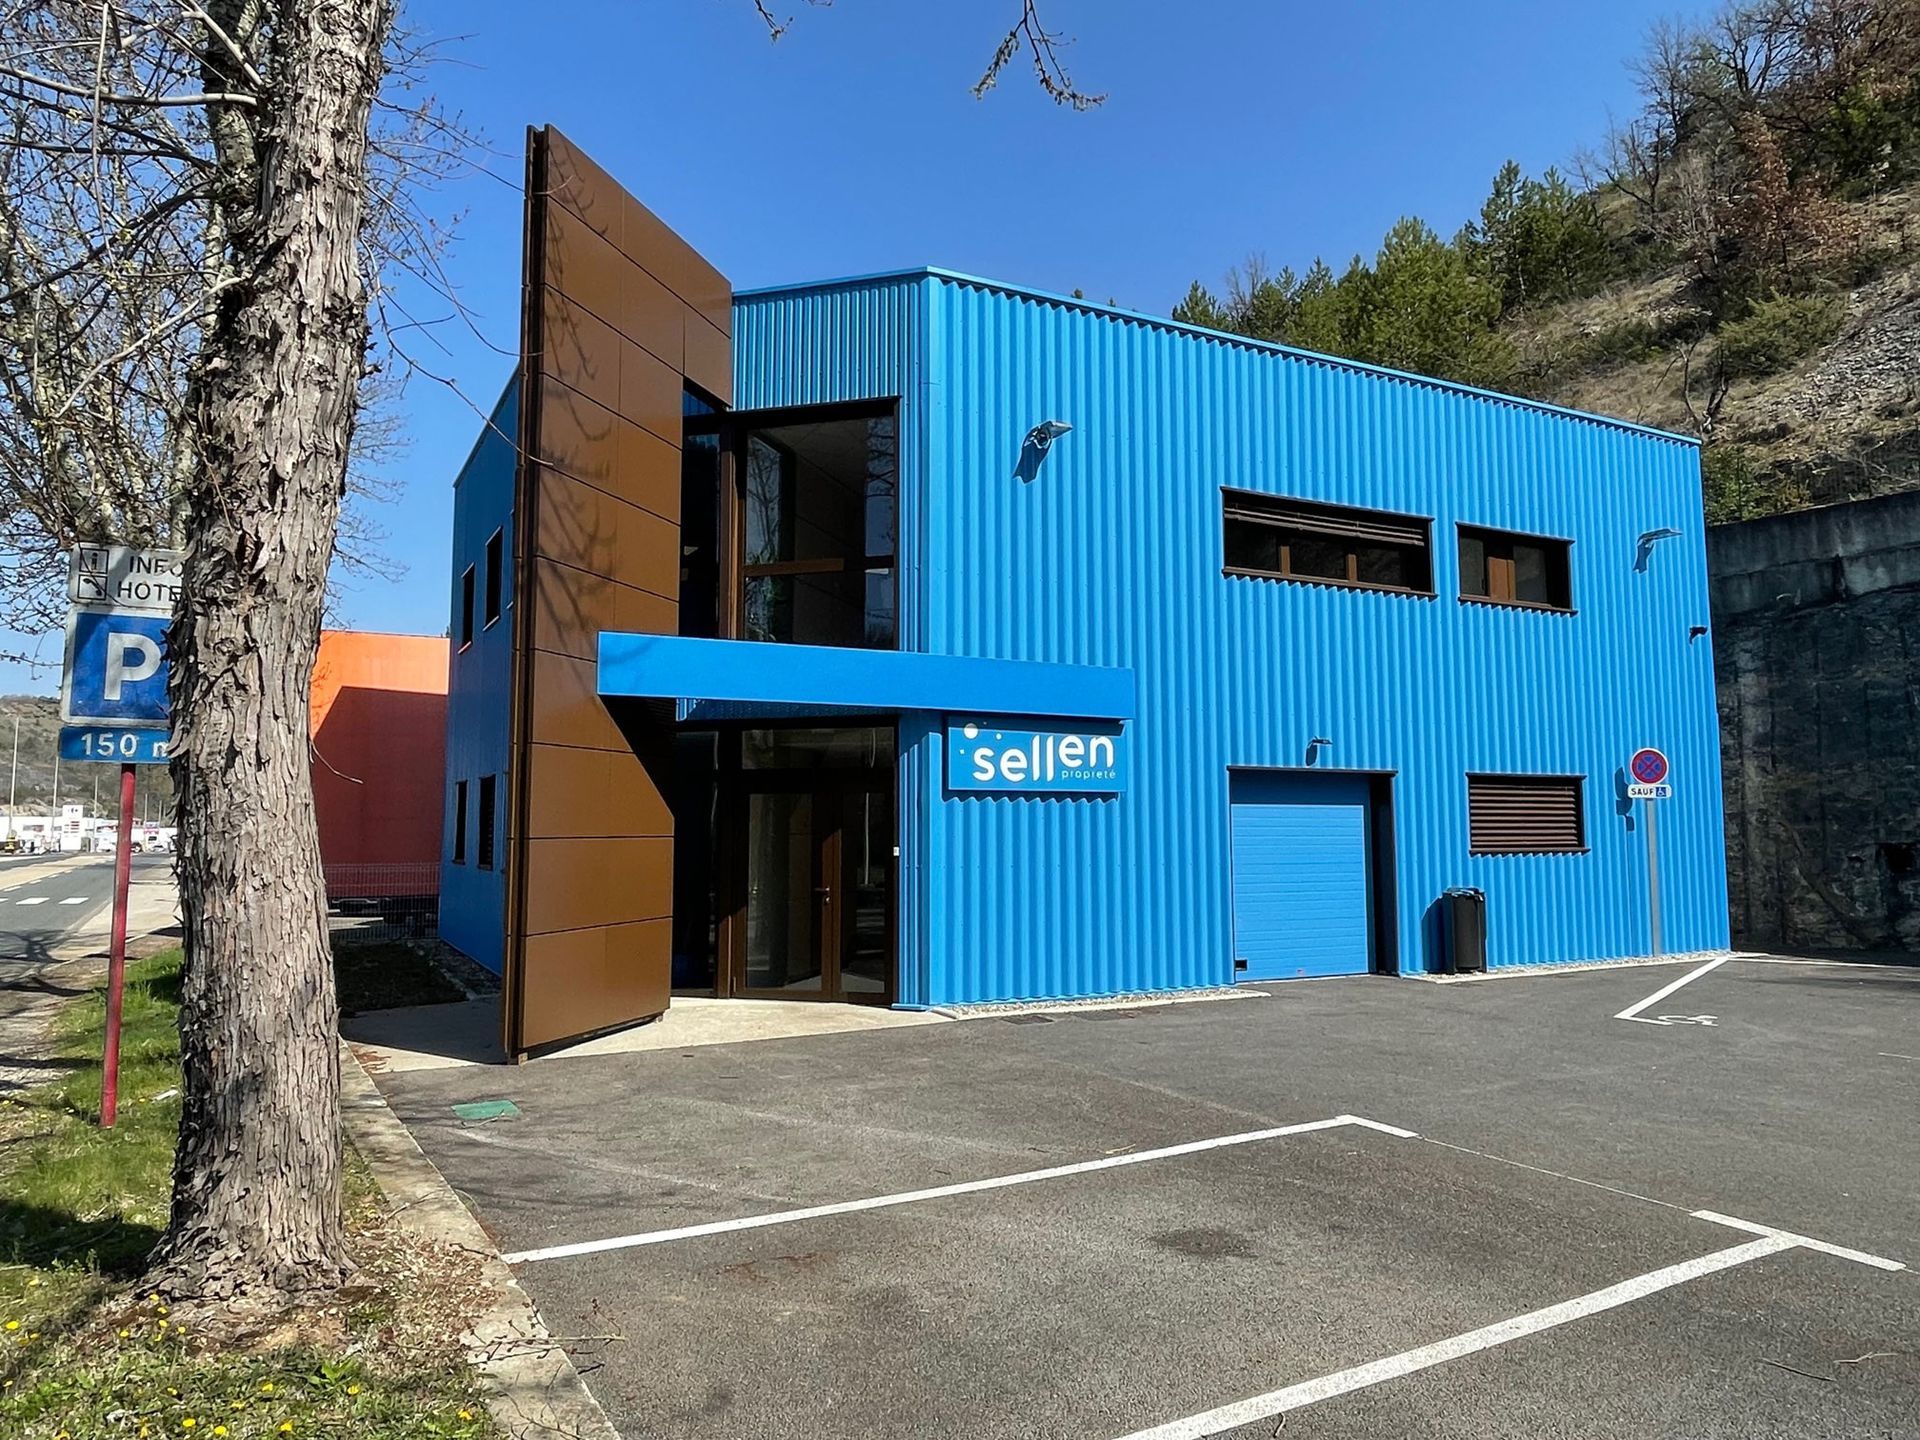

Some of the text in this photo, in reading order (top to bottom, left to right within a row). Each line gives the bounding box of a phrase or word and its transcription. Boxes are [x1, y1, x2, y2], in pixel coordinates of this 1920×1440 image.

[104, 632, 162, 701] P
[81, 732, 138, 757] 150
[972, 735, 1114, 782] sellen
[1631, 788, 1654, 796] SAUF
